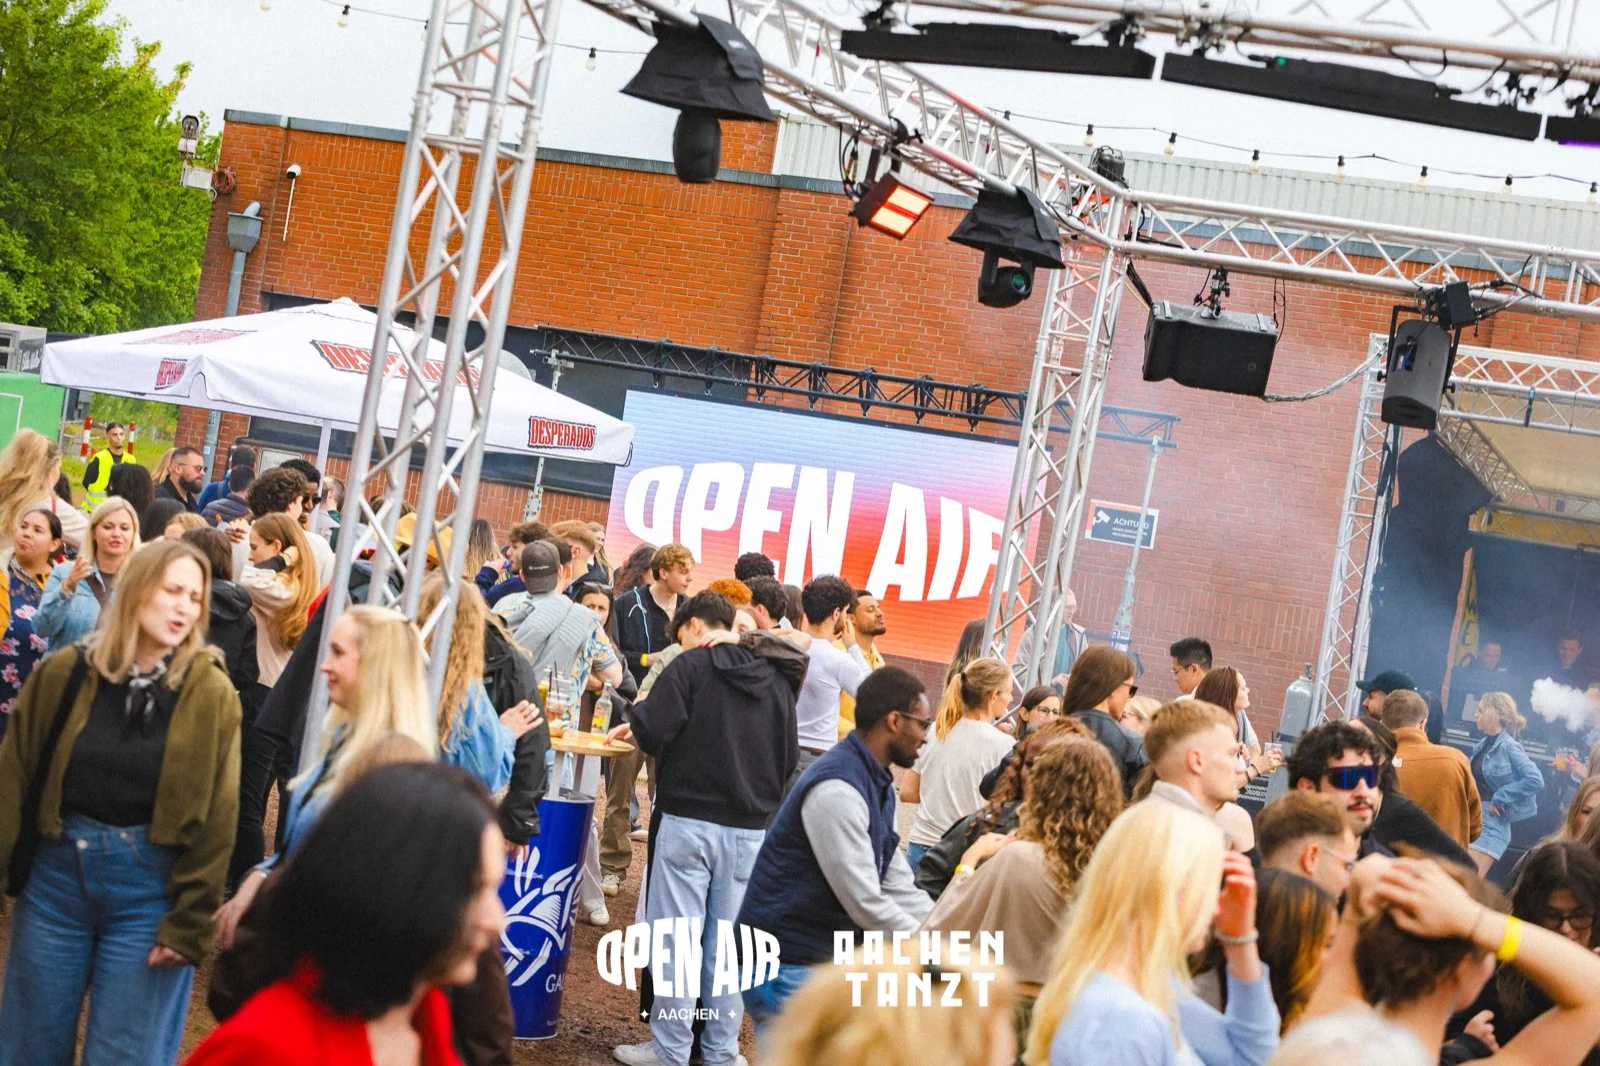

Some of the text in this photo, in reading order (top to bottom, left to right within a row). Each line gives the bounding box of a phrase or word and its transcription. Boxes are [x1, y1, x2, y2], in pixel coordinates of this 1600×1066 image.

[530, 417, 595, 448] DESPERADOS
[624, 461, 1019, 602] OPEN AIR
[1113, 517, 1150, 530] ACHTUG
